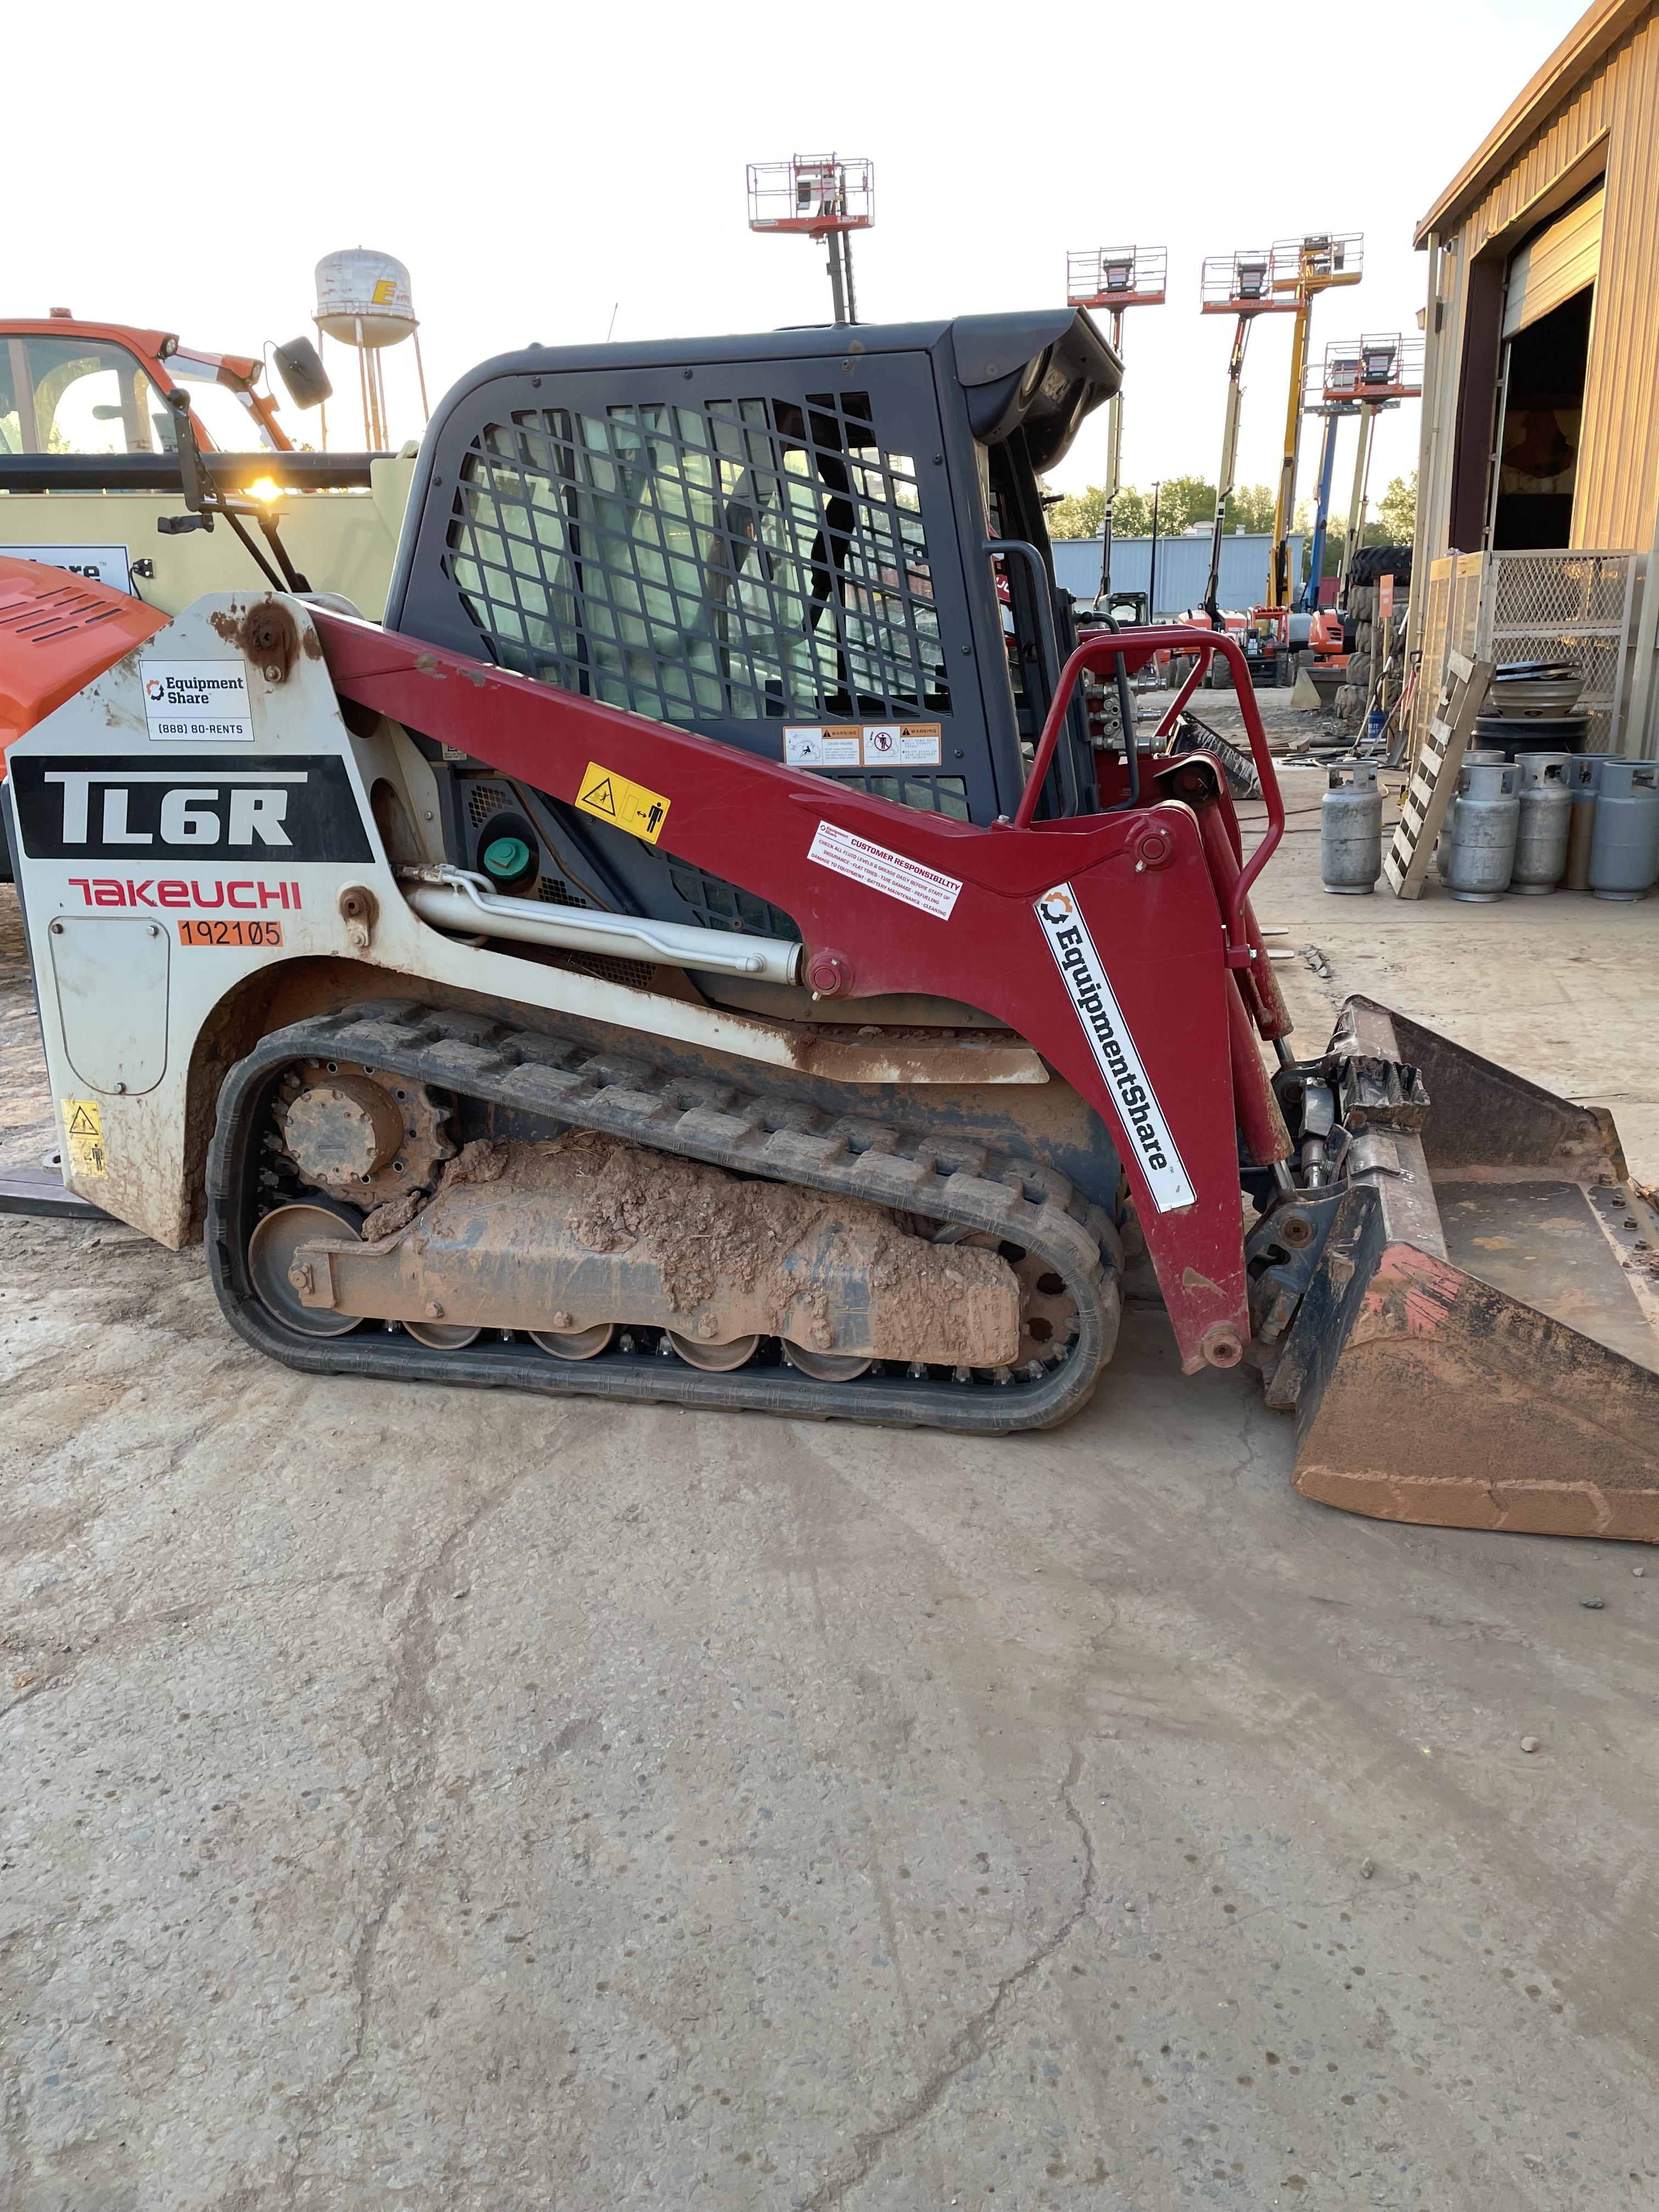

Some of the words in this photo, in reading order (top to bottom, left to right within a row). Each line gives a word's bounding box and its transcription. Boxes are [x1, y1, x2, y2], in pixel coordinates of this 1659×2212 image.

[371, 279, 397, 306] E
[166, 677, 244, 692] Equipment
[168, 692, 209, 704] Share
[159, 724, 188, 734] (888)
[191, 725, 243, 733] 80-RENTS
[44, 771, 308, 845] TL6R
[811, 853, 830, 864] DAMAGE
[838, 865, 864, 879] EQUIPMENT
[867, 878, 887, 889] BATTERY
[888, 887, 921, 905] MAINTENANCE
[923, 903, 946, 916] CLEANING
[819, 839, 833, 849] CHECK
[843, 850, 856, 859] FLUID
[857, 856, 873, 866] LEVELS
[878, 865, 896, 877] GREASE
[896, 874, 910, 882] DAILY
[910, 880, 928, 891] BEFORE
[928, 888, 943, 898] START
[823, 850, 850, 865] INSURANCE
[864, 868, 877, 877] TIRES
[892, 880, 911, 892] DAMAGE
[915, 890, 939, 905] REFUELING
[851, 839, 893, 861] CUSTOMER
[894, 857, 960, 891] RESPONSIBILITY
[69, 879, 302, 910] TAKEUCHI
[181, 921, 280, 946] 192105
[1056, 925, 1167, 1171] EquipmentShare
